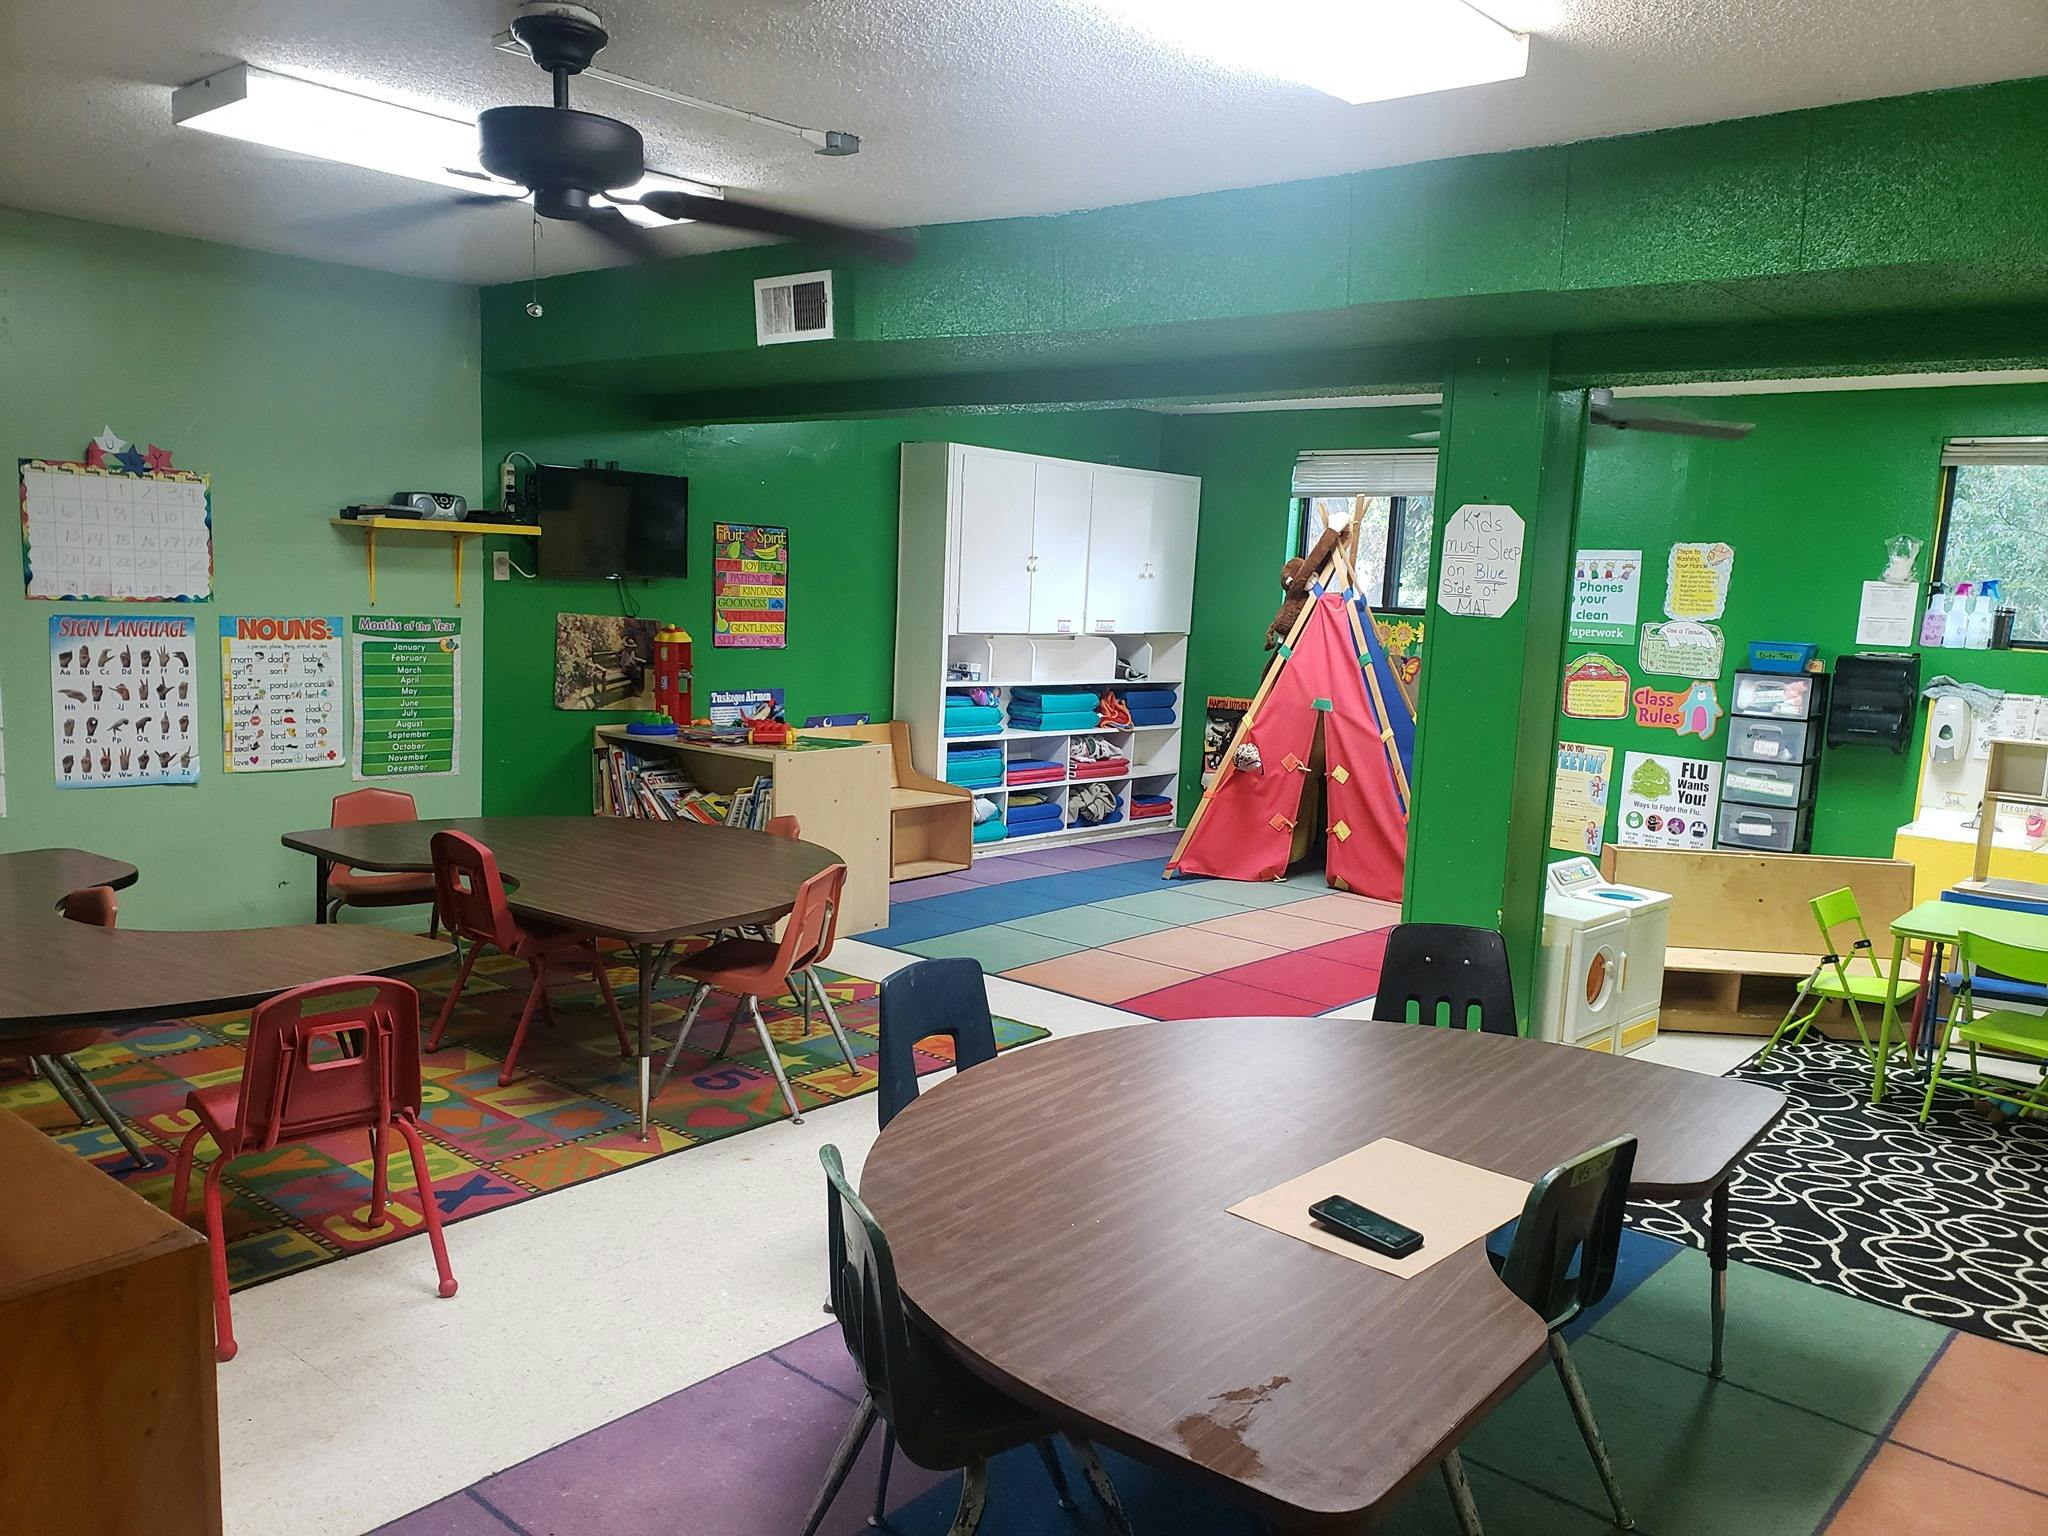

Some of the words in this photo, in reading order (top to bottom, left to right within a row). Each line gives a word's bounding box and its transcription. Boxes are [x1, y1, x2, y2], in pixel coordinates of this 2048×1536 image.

[1463, 509, 1503, 533] Kids
[716, 525, 745, 542] Fruit
[757, 528, 786, 548] Spirit
[1445, 537, 1483, 556] must
[1486, 538, 1521, 565] Sleep
[744, 561, 758, 571] JOY
[761, 562, 785, 571] PEACE
[1447, 565, 1465, 576] on
[1474, 562, 1508, 580] Blue
[730, 573, 770, 583] PATIENCE
[742, 586, 784, 596] KINDNESS
[1442, 578, 1473, 595] Side
[1482, 582, 1499, 597] of
[1580, 580, 1624, 593] Phones
[718, 598, 768, 608] GOODNESS
[1455, 598, 1492, 616] MAT
[1580, 595, 1608, 607] your
[1576, 609, 1609, 621] clean
[58, 617, 99, 637] SIGN
[104, 617, 188, 637] LANGUAGE
[237, 618, 333, 641] NOUNS:
[358, 617, 402, 631] Months
[403, 620, 416, 631] of
[416, 621, 431, 631] the
[432, 618, 455, 632] Year
[731, 623, 784, 633] GENTLENESS
[393, 643, 426, 652] January
[267, 653, 284, 663] dad
[303, 653, 321, 665] baby
[391, 654, 427, 663] February
[232, 666, 246, 679] girl
[304, 665, 317, 677] boy
[397, 666, 422, 674] March
[270, 680, 288, 691] pond
[400, 676, 420, 685] April
[234, 691, 253, 704] park
[270, 693, 291, 703] camp
[305, 690, 319, 699] tent
[401, 687, 418, 696] May
[711, 692, 745, 705] Tuskegee
[746, 690, 772, 702] Airmen
[1634, 689, 1674, 708] Class
[234, 706, 251, 715] slide
[305, 703, 322, 713] clock
[401, 709, 418, 718] July
[234, 720, 249, 730] sign
[270, 717, 283, 726] hat
[305, 716, 321, 724] tree
[1639, 708, 1680, 725] Rules
[396, 720, 423, 730] August
[234, 732, 253, 744] tiger
[270, 730, 286, 739] bird
[305, 728, 318, 738] lion
[387, 731, 431, 740] September
[234, 743, 250, 753] seal
[270, 742, 284, 754] dog
[305, 740, 317, 749] cat
[392, 743, 426, 751] October
[1567, 744, 1574, 752] DO
[1575, 745, 1585, 754] YOU
[233, 757, 249, 766] love
[270, 757, 293, 767] peace
[305, 752, 327, 761] health
[388, 753, 428, 762] November
[1560, 752, 1607, 775] EETH?
[387, 764, 428, 773] December
[1681, 762, 1709, 780] FLU
[1677, 778, 1710, 792] Wants
[1678, 790, 1707, 807] You!
[1633, 800, 1650, 809] Ways
[1659, 804, 1676, 813] Fight
[1689, 808, 1702, 816] Flu.
